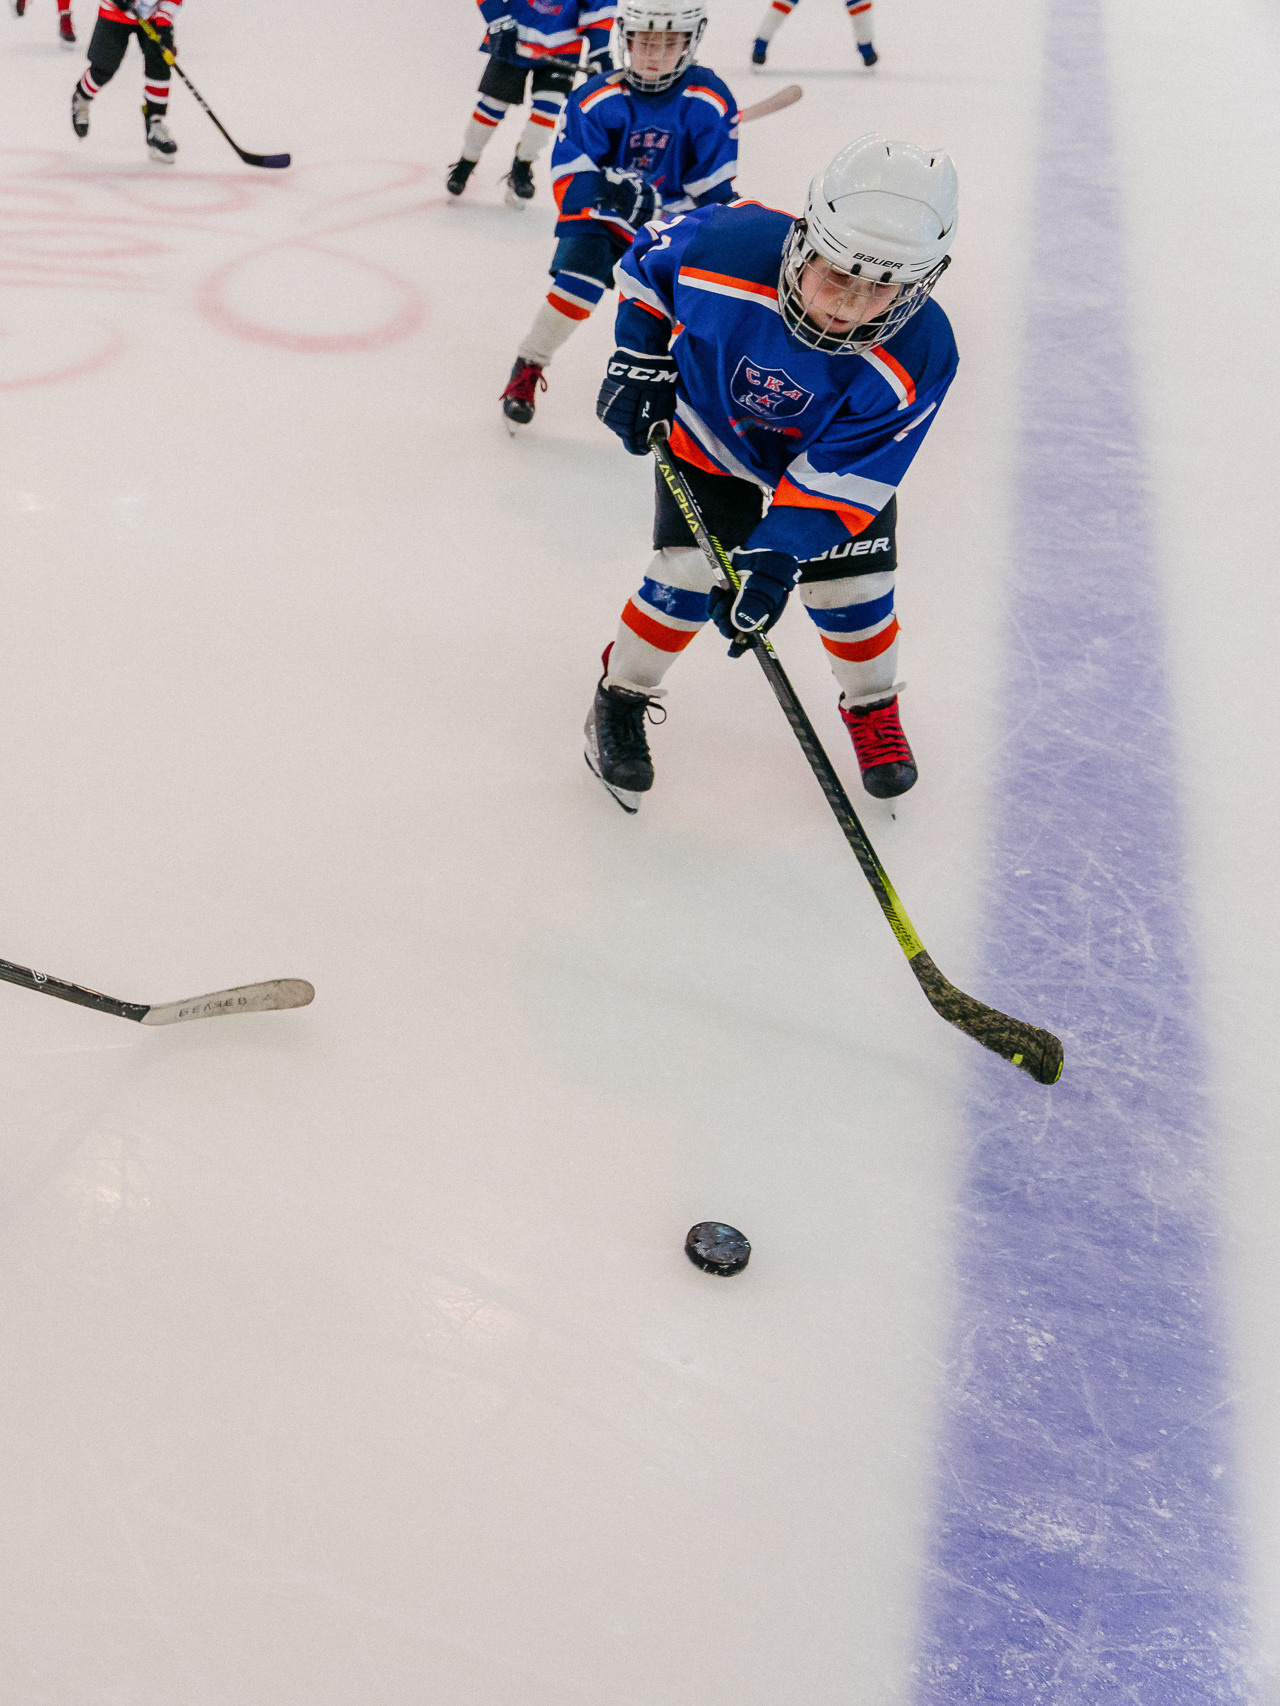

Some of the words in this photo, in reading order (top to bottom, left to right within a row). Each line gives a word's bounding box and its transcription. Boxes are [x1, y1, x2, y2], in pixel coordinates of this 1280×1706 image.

[853, 252, 905, 270] BAUER
[608, 361, 679, 383] CCM
[745, 367, 803, 400] СКА
[659, 464, 700, 534] ALPHA
[797, 536, 891, 563] UER
